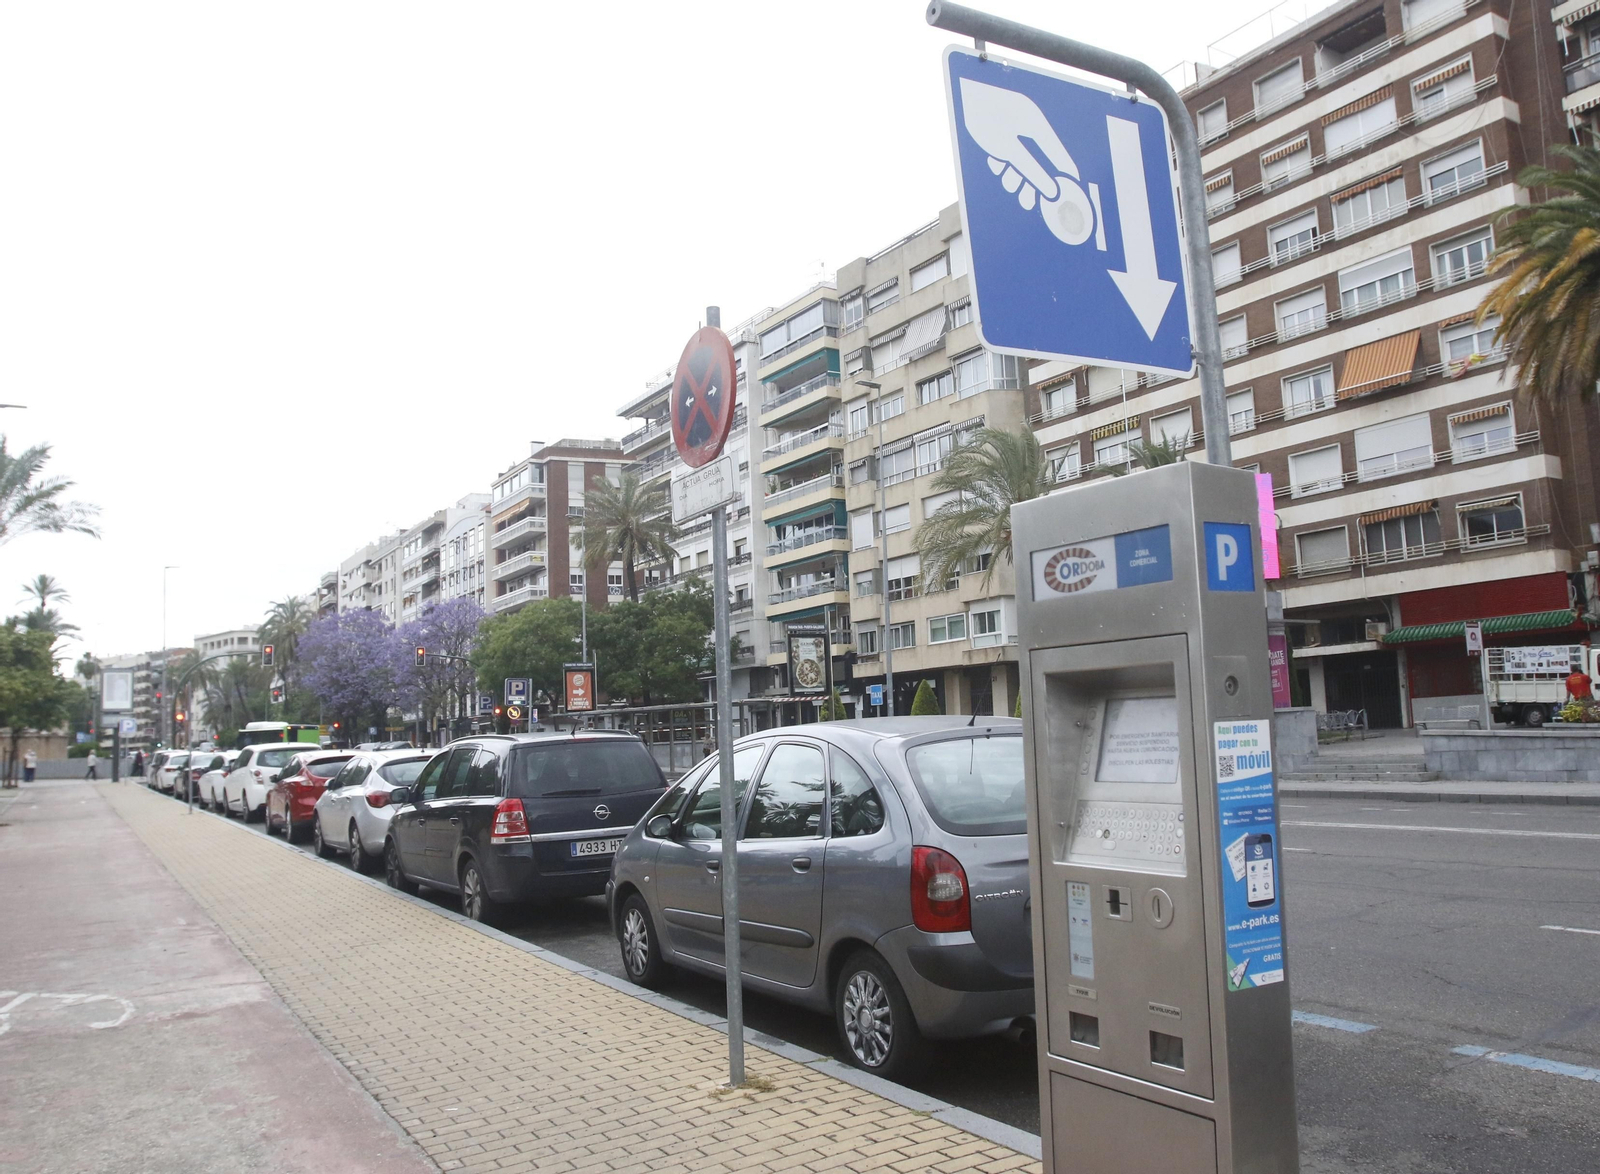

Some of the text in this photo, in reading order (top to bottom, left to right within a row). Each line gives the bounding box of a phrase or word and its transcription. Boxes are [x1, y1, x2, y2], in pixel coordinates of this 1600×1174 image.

[1134, 548, 1150, 557] ZONA
[1215, 533, 1238, 581] P
[1129, 556, 1158, 567] COMERCIAL
[511, 681, 524, 696] P
[121, 720, 134, 731] P
[1232, 724, 1258, 735] puedes
[1218, 738, 1258, 750] pagar con tu
[1236, 750, 1270, 770] móvil
[579, 841, 606, 854] 4933
[1228, 914, 1280, 931] www.e-park.es
[1263, 952, 1282, 963] GRATIS
